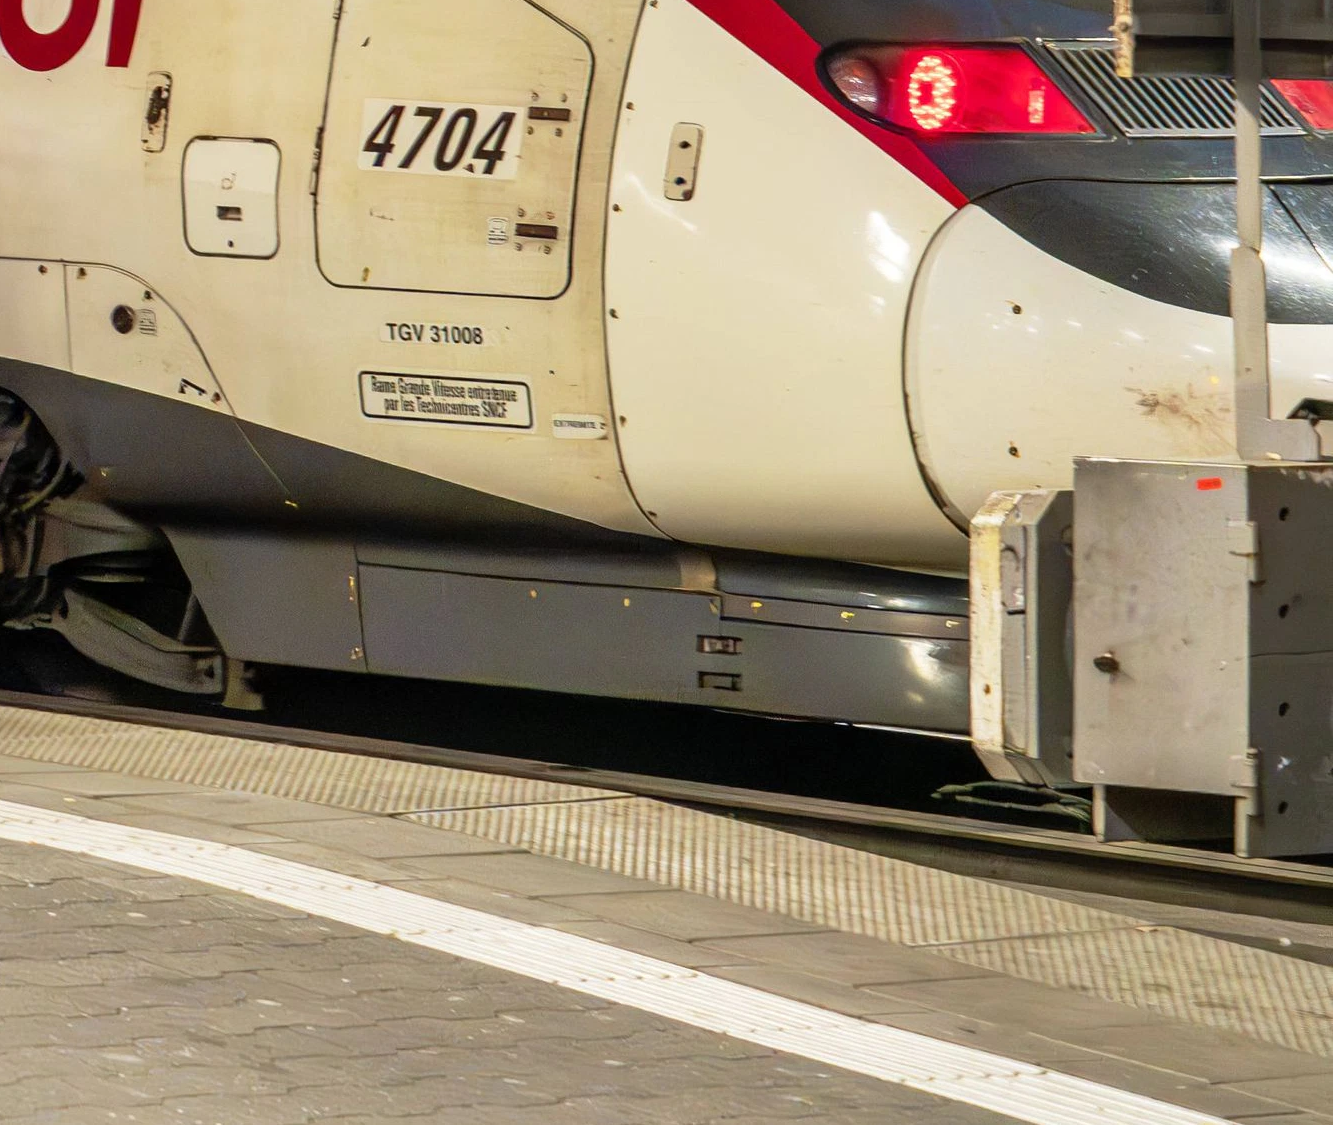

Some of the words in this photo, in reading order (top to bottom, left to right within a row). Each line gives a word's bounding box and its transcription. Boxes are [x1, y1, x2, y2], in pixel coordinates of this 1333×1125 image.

[362, 105, 517, 175] 4704
[385, 322, 424, 342] TGV
[430, 325, 484, 345] 31008
